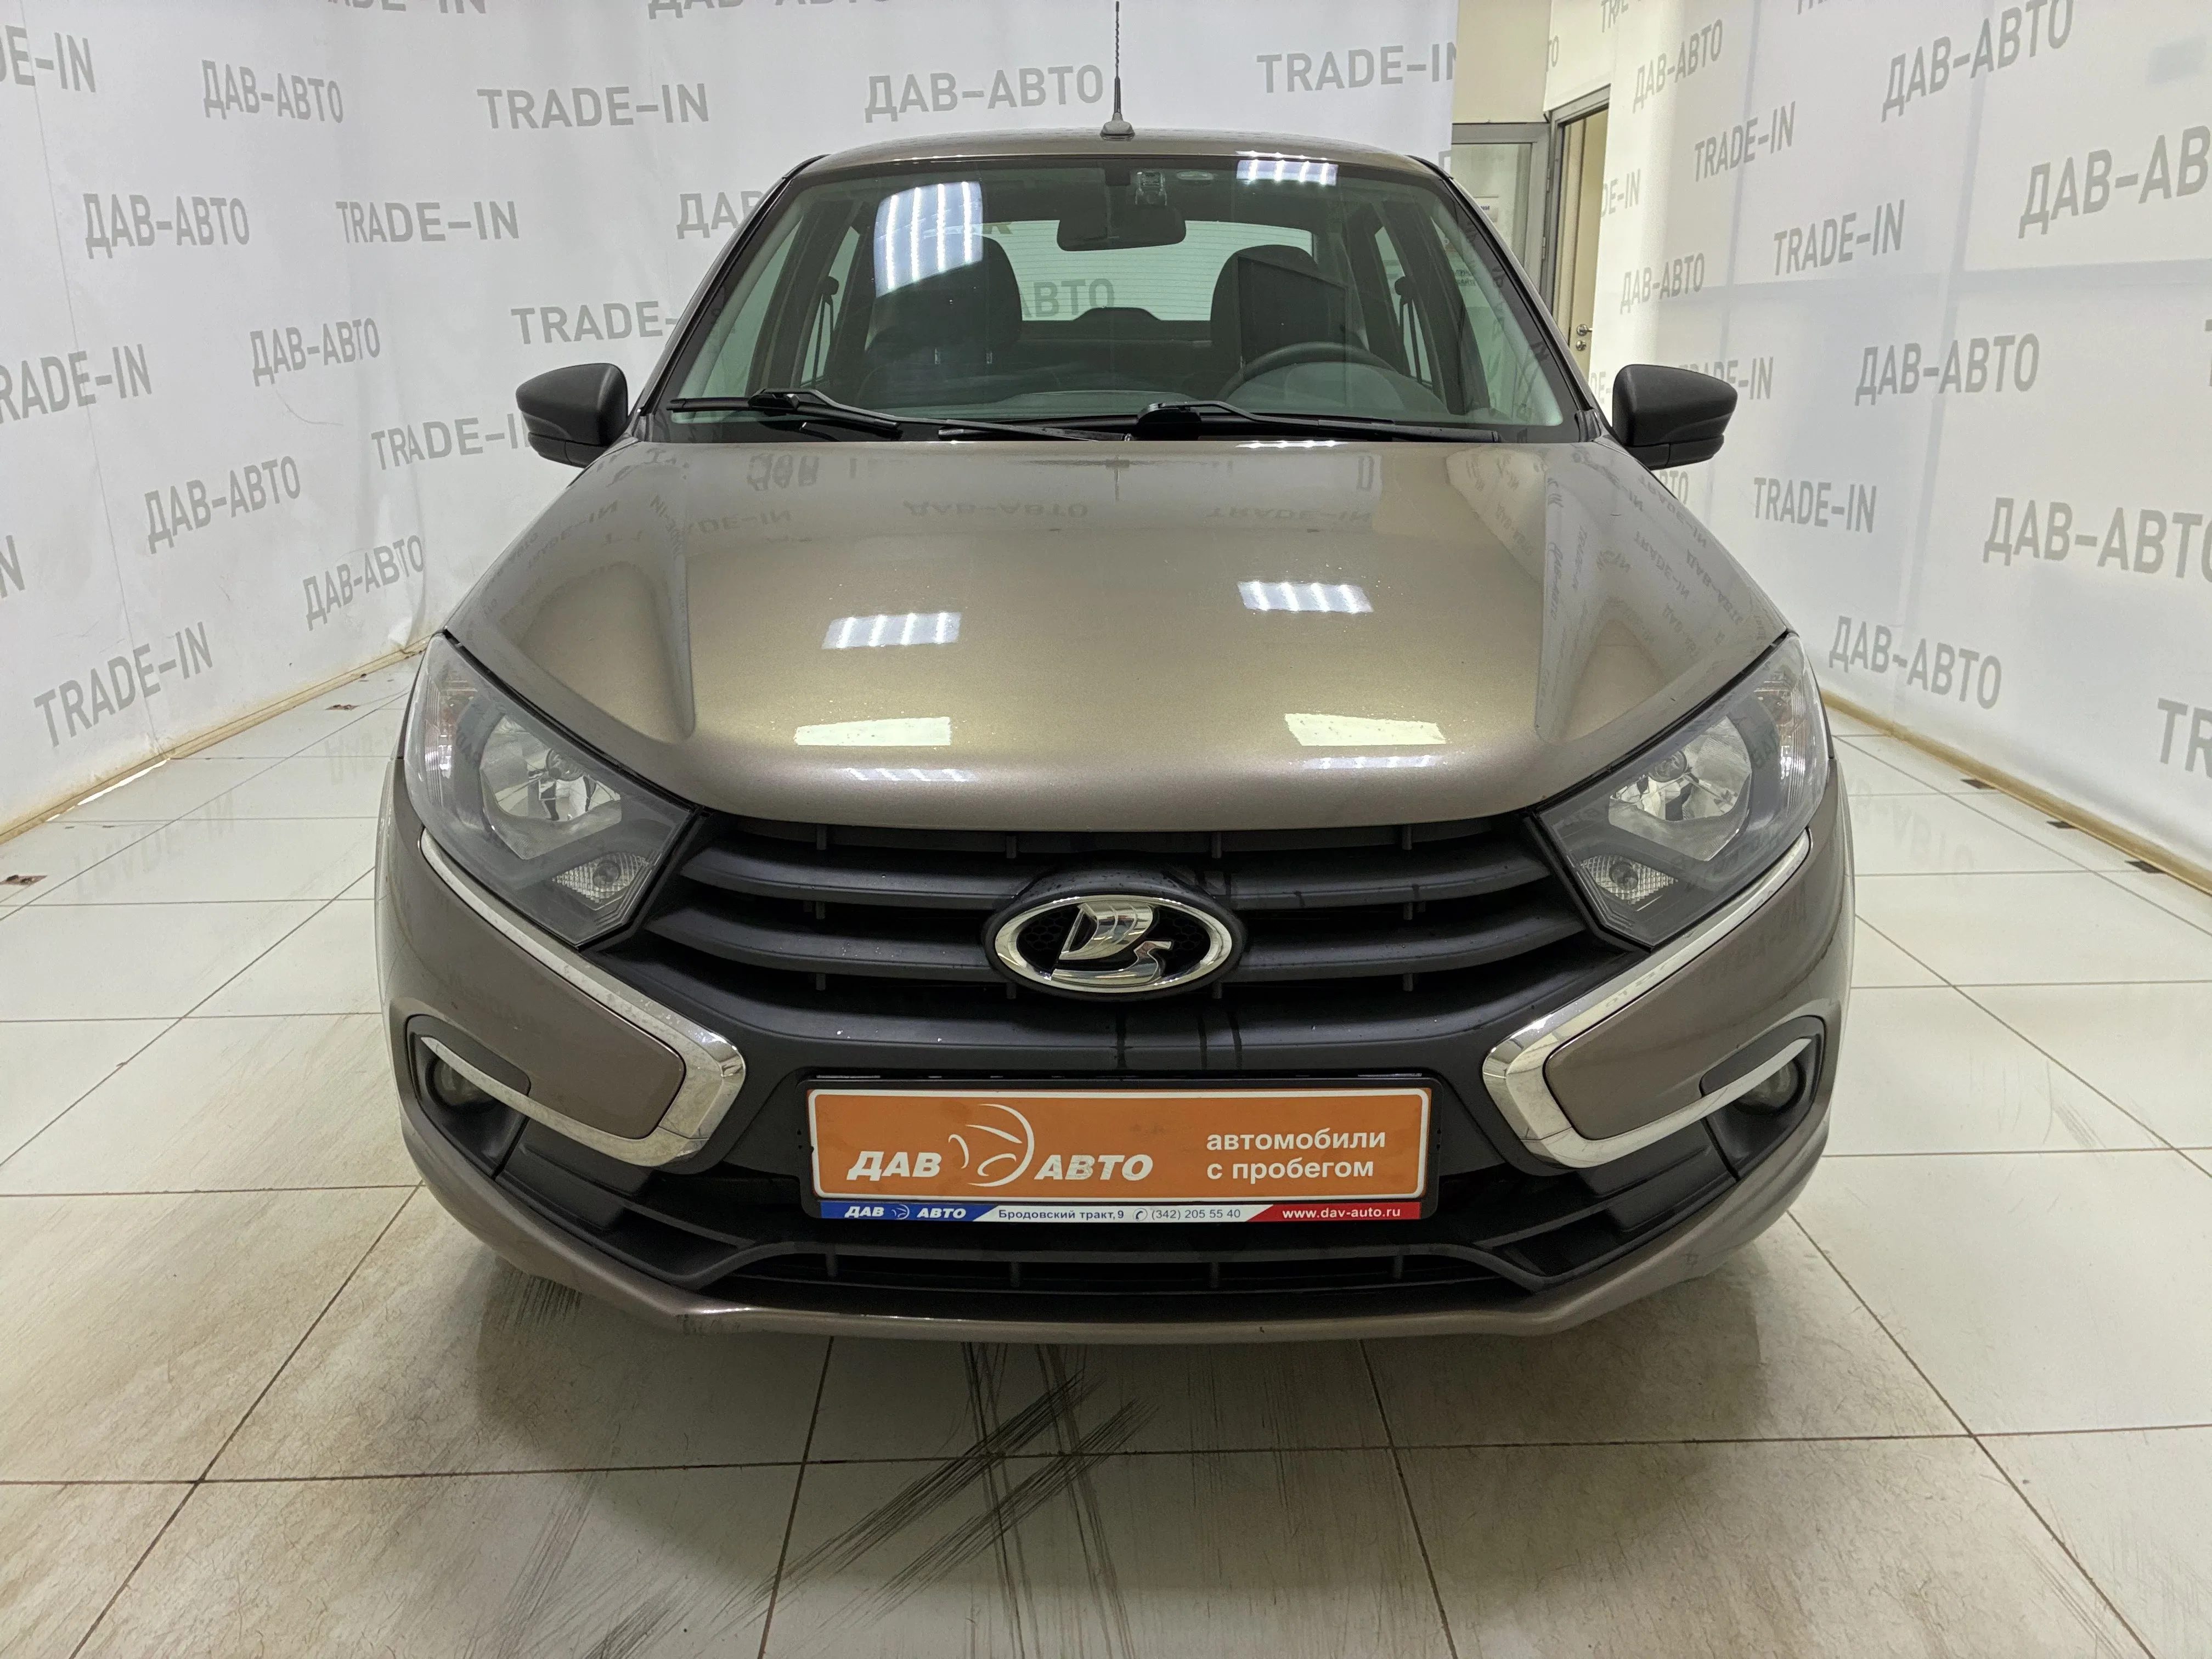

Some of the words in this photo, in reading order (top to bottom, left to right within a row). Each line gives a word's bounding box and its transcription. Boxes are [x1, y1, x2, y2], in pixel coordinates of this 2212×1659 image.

[202, 60, 343, 123] ДАВ-АВТО
[1633, 19, 1723, 114] ДАВ-АВТО
[1881, 0, 2074, 122] ДАВ-АВТО
[477, 83, 709, 129] TRADE-IN
[865, 64, 1103, 123] ДАВ-АВТО
[1694, 101, 1796, 182] TRADE-IN
[83, 193, 250, 259] ДАВ-АВТО
[336, 201, 519, 243] TRADE-IN
[1774, 199, 1905, 275] TRADE-IN
[1620, 253, 1705, 314] ДАВ-АВТО
[250, 318, 380, 387] ДАВ-АВТО
[1855, 333, 2039, 406] ДАВ-АВТО
[371, 413, 530, 470] TRADE-I
[145, 456, 301, 554] ДАВ-АВТО
[1754, 477, 1876, 533] TRADE-IN
[302, 535, 425, 631] ДАВ-АВТО
[33, 622, 213, 748] TRADE-IN
[1829, 616, 2002, 709] ДАВ-АВТО
[846, 1151, 942, 1181] ДАВ
[1034, 1154, 1153, 1181] АВТО
[1206, 1127, 1385, 1150] автомобили
[1207, 1164, 1222, 1180] с
[1232, 1157, 1374, 1184] пробегом
[844, 1206, 884, 1218] ДАВ
[917, 1208, 966, 1219] АВТО
[999, 1210, 1075, 1220] Бродовский
[1152, 1210, 1181, 1221] (342)
[1184, 1210, 1205, 1218] 205
[1209, 1210, 1224, 1218] 55
[1227, 1209, 1241, 1218] 40
[1282, 1208, 1401, 1219] www.dav-auto.ru
